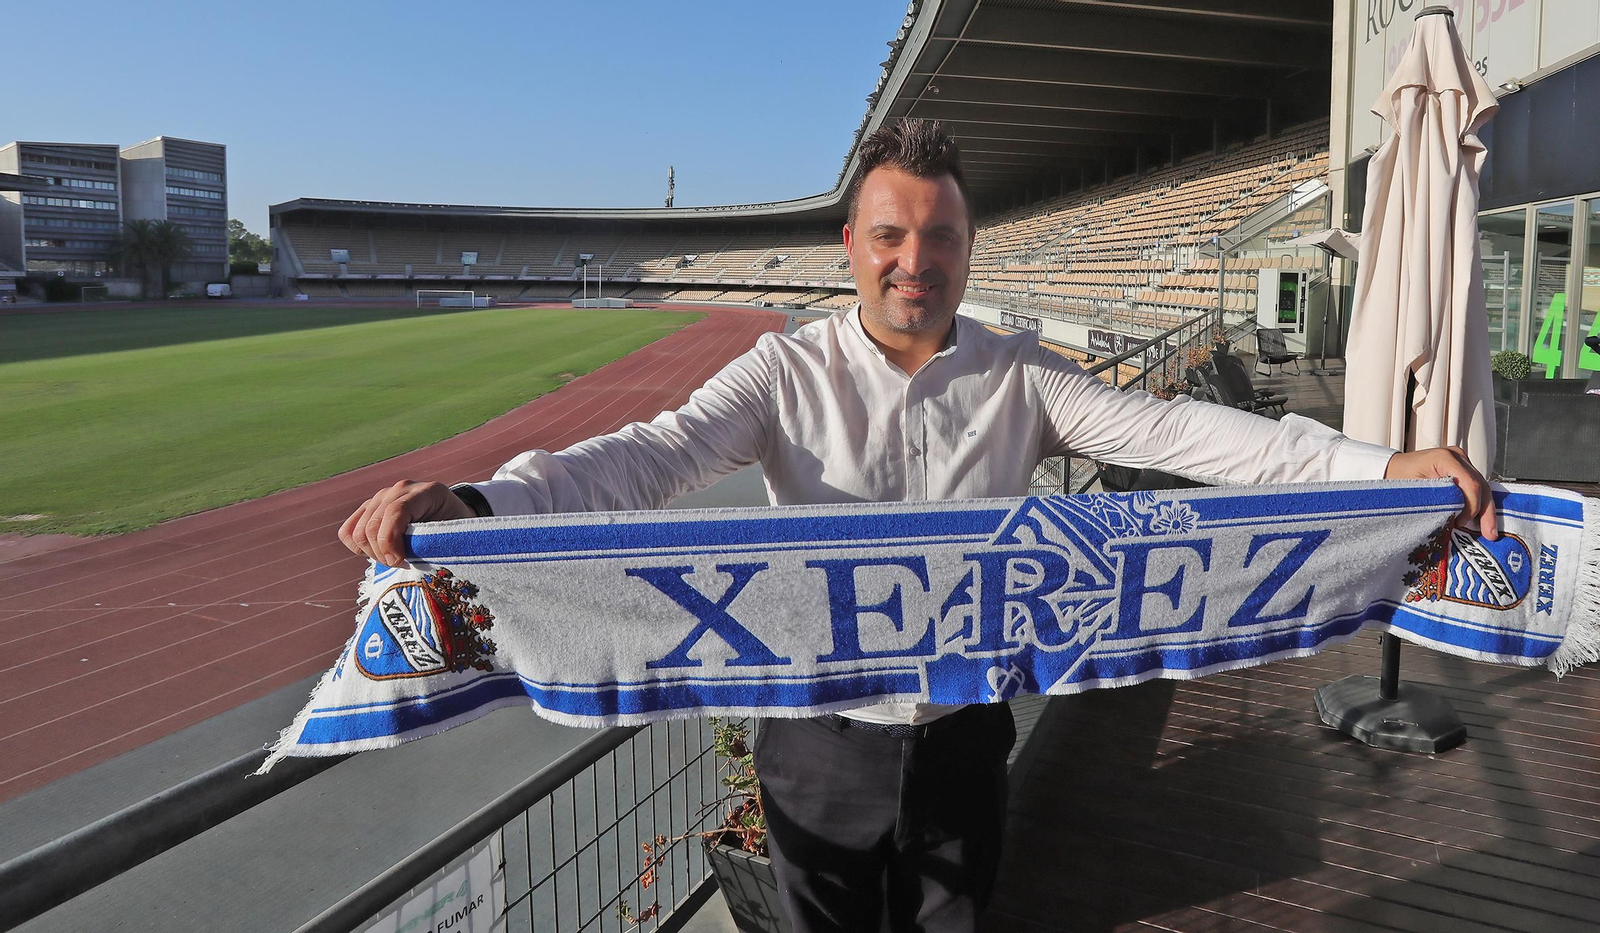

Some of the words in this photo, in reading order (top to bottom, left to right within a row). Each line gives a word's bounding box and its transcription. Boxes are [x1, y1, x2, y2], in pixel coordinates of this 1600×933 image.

[624, 528, 1332, 670] XEREZ
[1453, 531, 1514, 600] XEREZ
[1536, 543, 1559, 617] XEREZ
[381, 598, 442, 667] XEREZ
[437, 894, 484, 933] FUMAR
